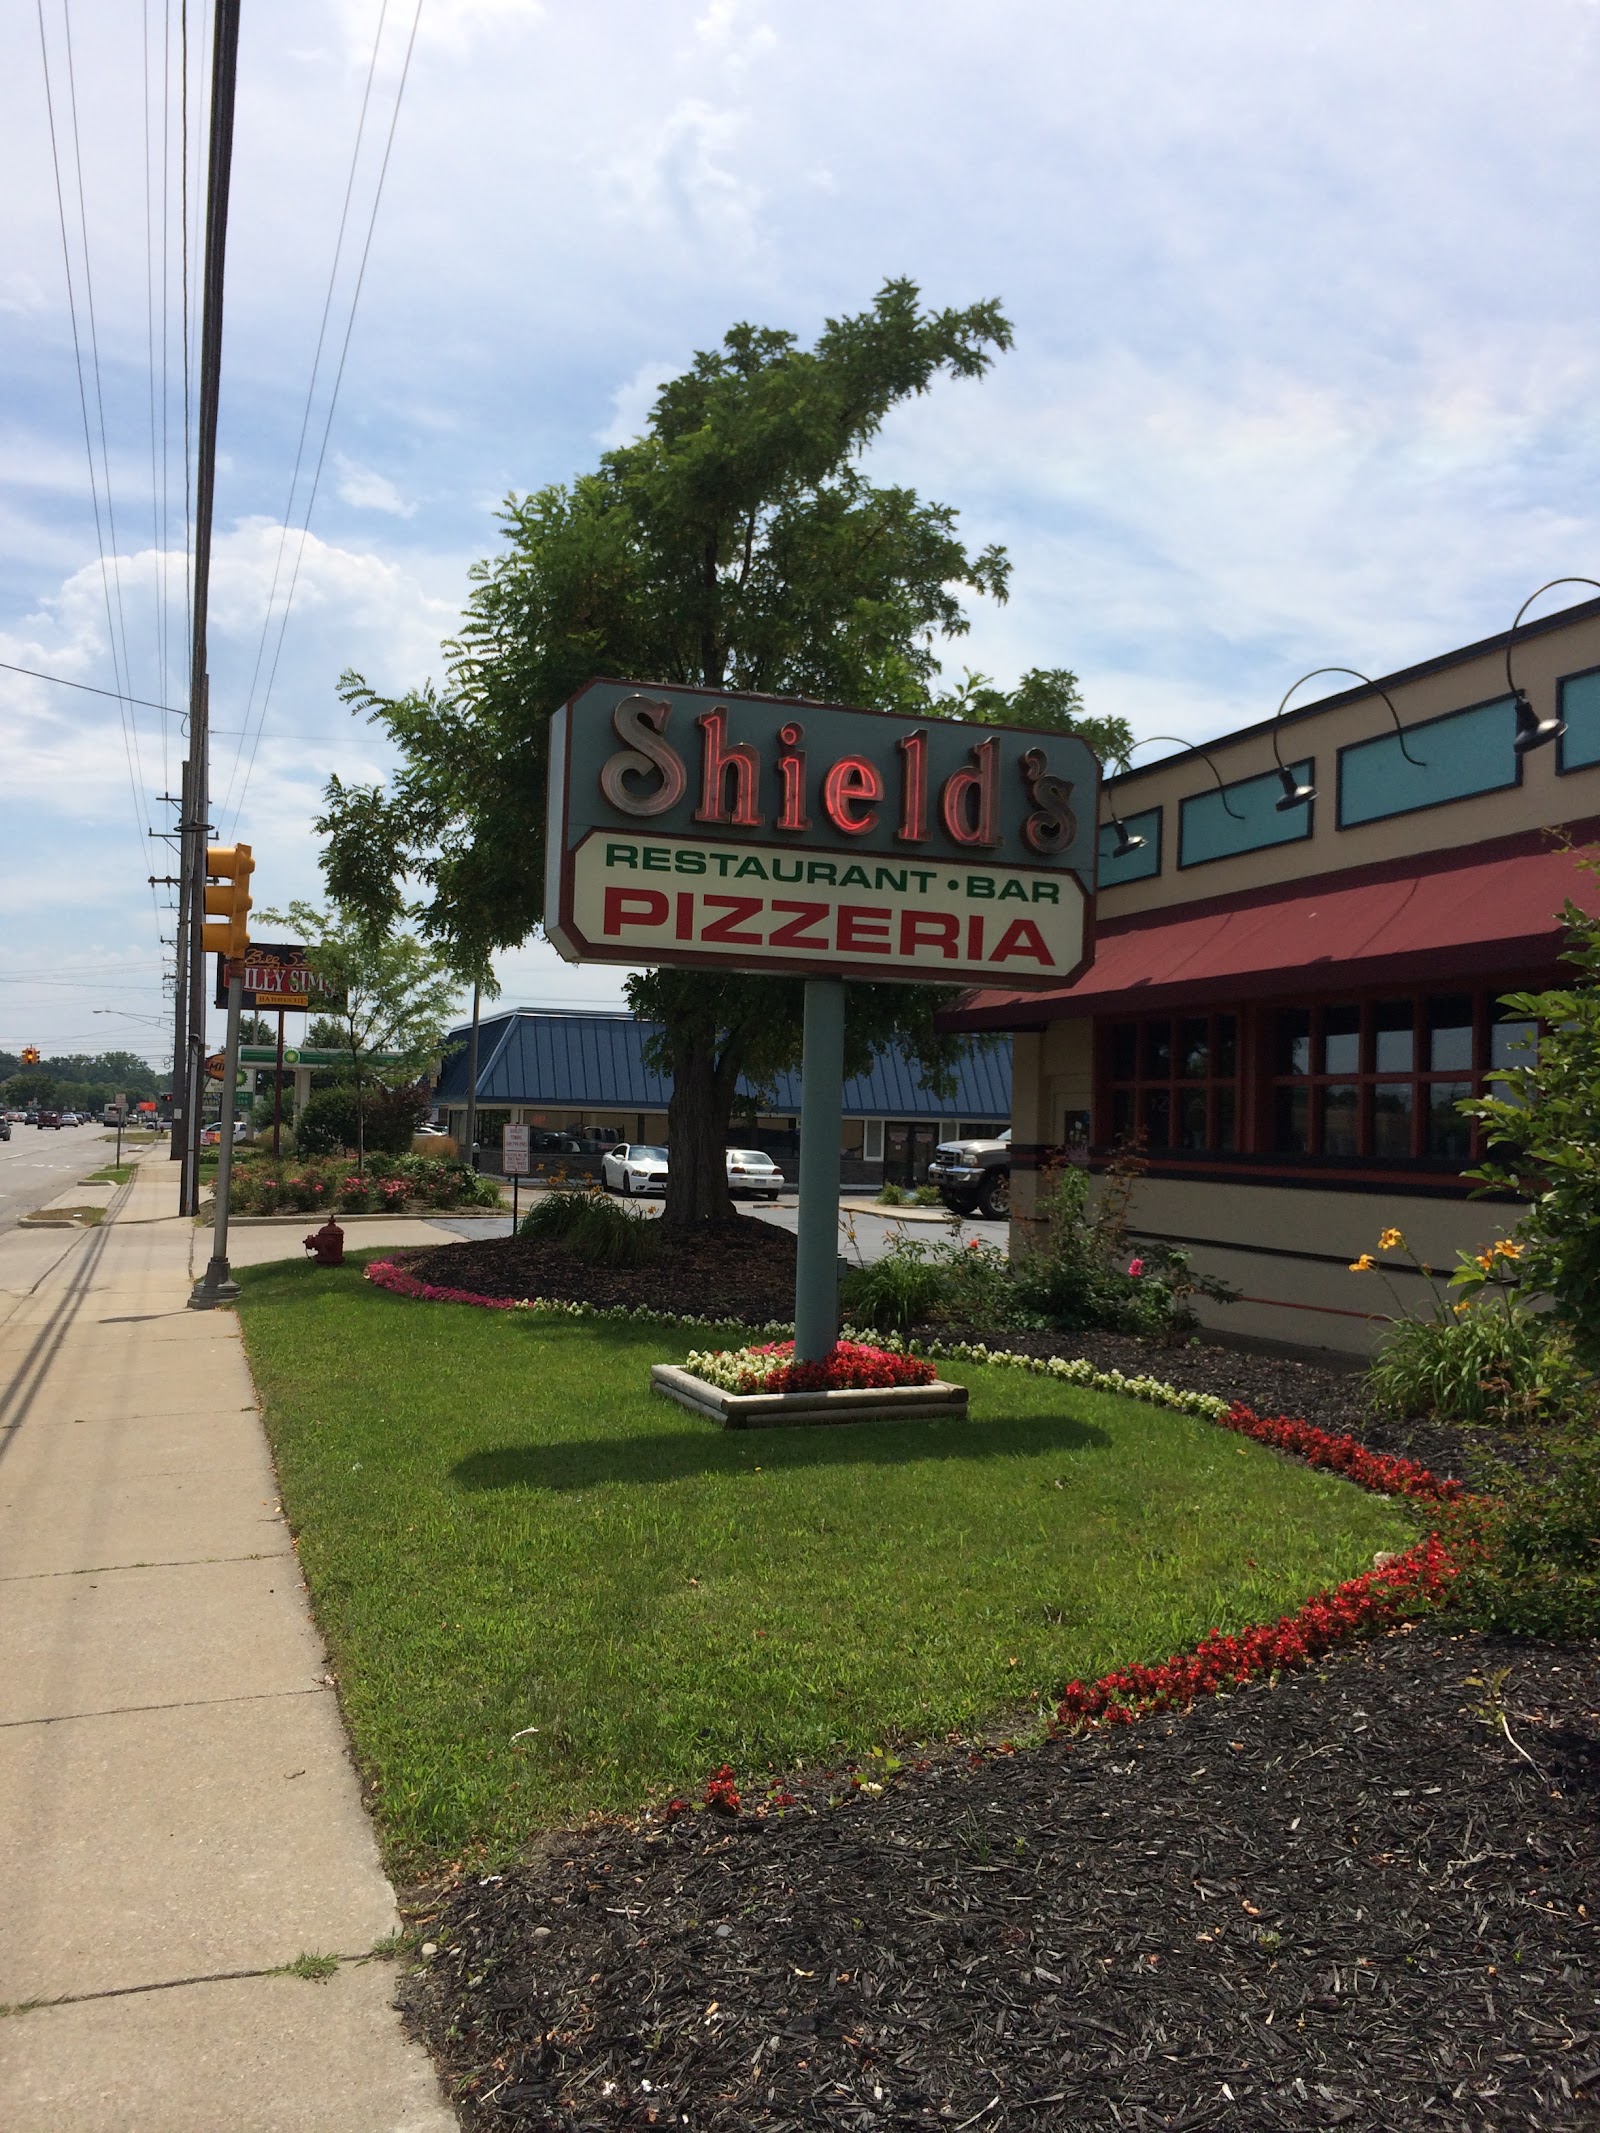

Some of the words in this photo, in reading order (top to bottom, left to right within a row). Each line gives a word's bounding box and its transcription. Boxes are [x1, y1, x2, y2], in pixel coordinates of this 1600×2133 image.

[601, 693, 1078, 855] Shield's
[605, 843, 938, 894] RESTAURANT
[966, 876, 1060, 905] BAR
[603, 886, 1056, 967] PIZZERIA
[244, 967, 286, 992] ILLY
